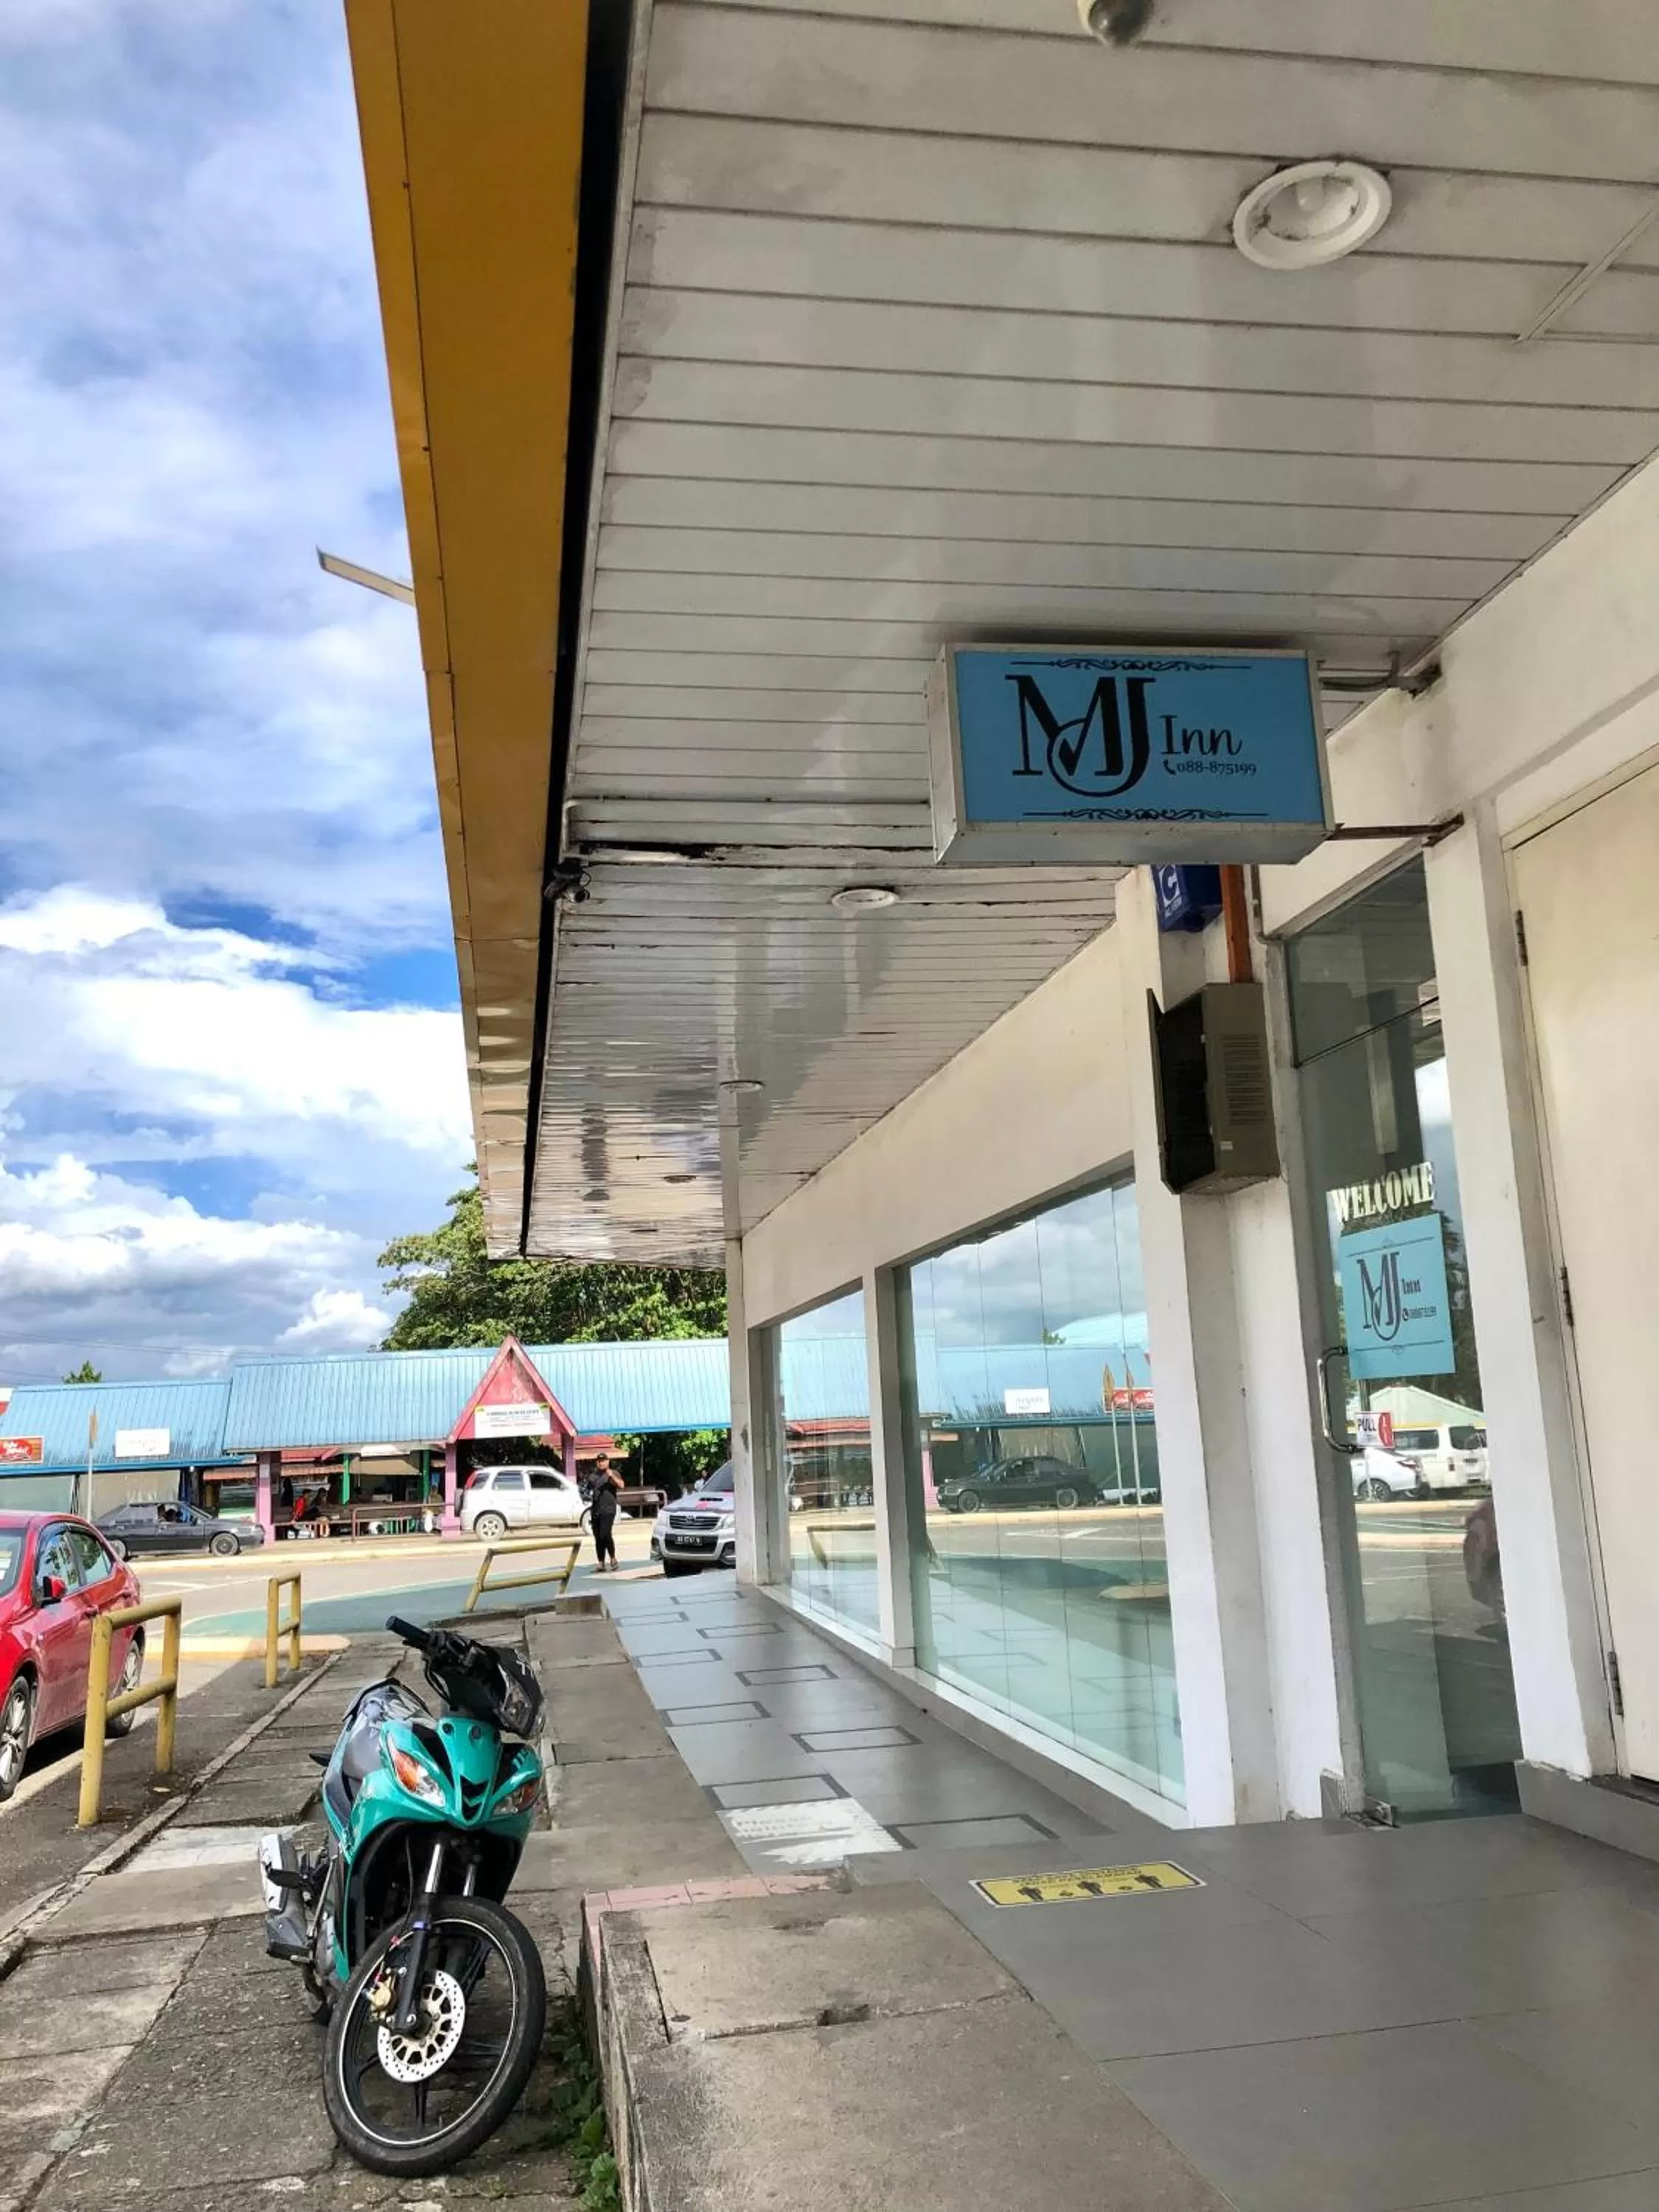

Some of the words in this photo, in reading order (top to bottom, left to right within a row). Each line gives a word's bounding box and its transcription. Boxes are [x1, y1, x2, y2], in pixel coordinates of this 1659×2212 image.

[1005, 675, 1156, 797] MJ
[1158, 714, 1242, 755] Inn
[1177, 761, 1256, 776] 088-875199
[1330, 1162, 1435, 1222] WELCOME
[1357, 1252, 1402, 1340] MJ
[1357, 1418, 1377, 1431] PULL
